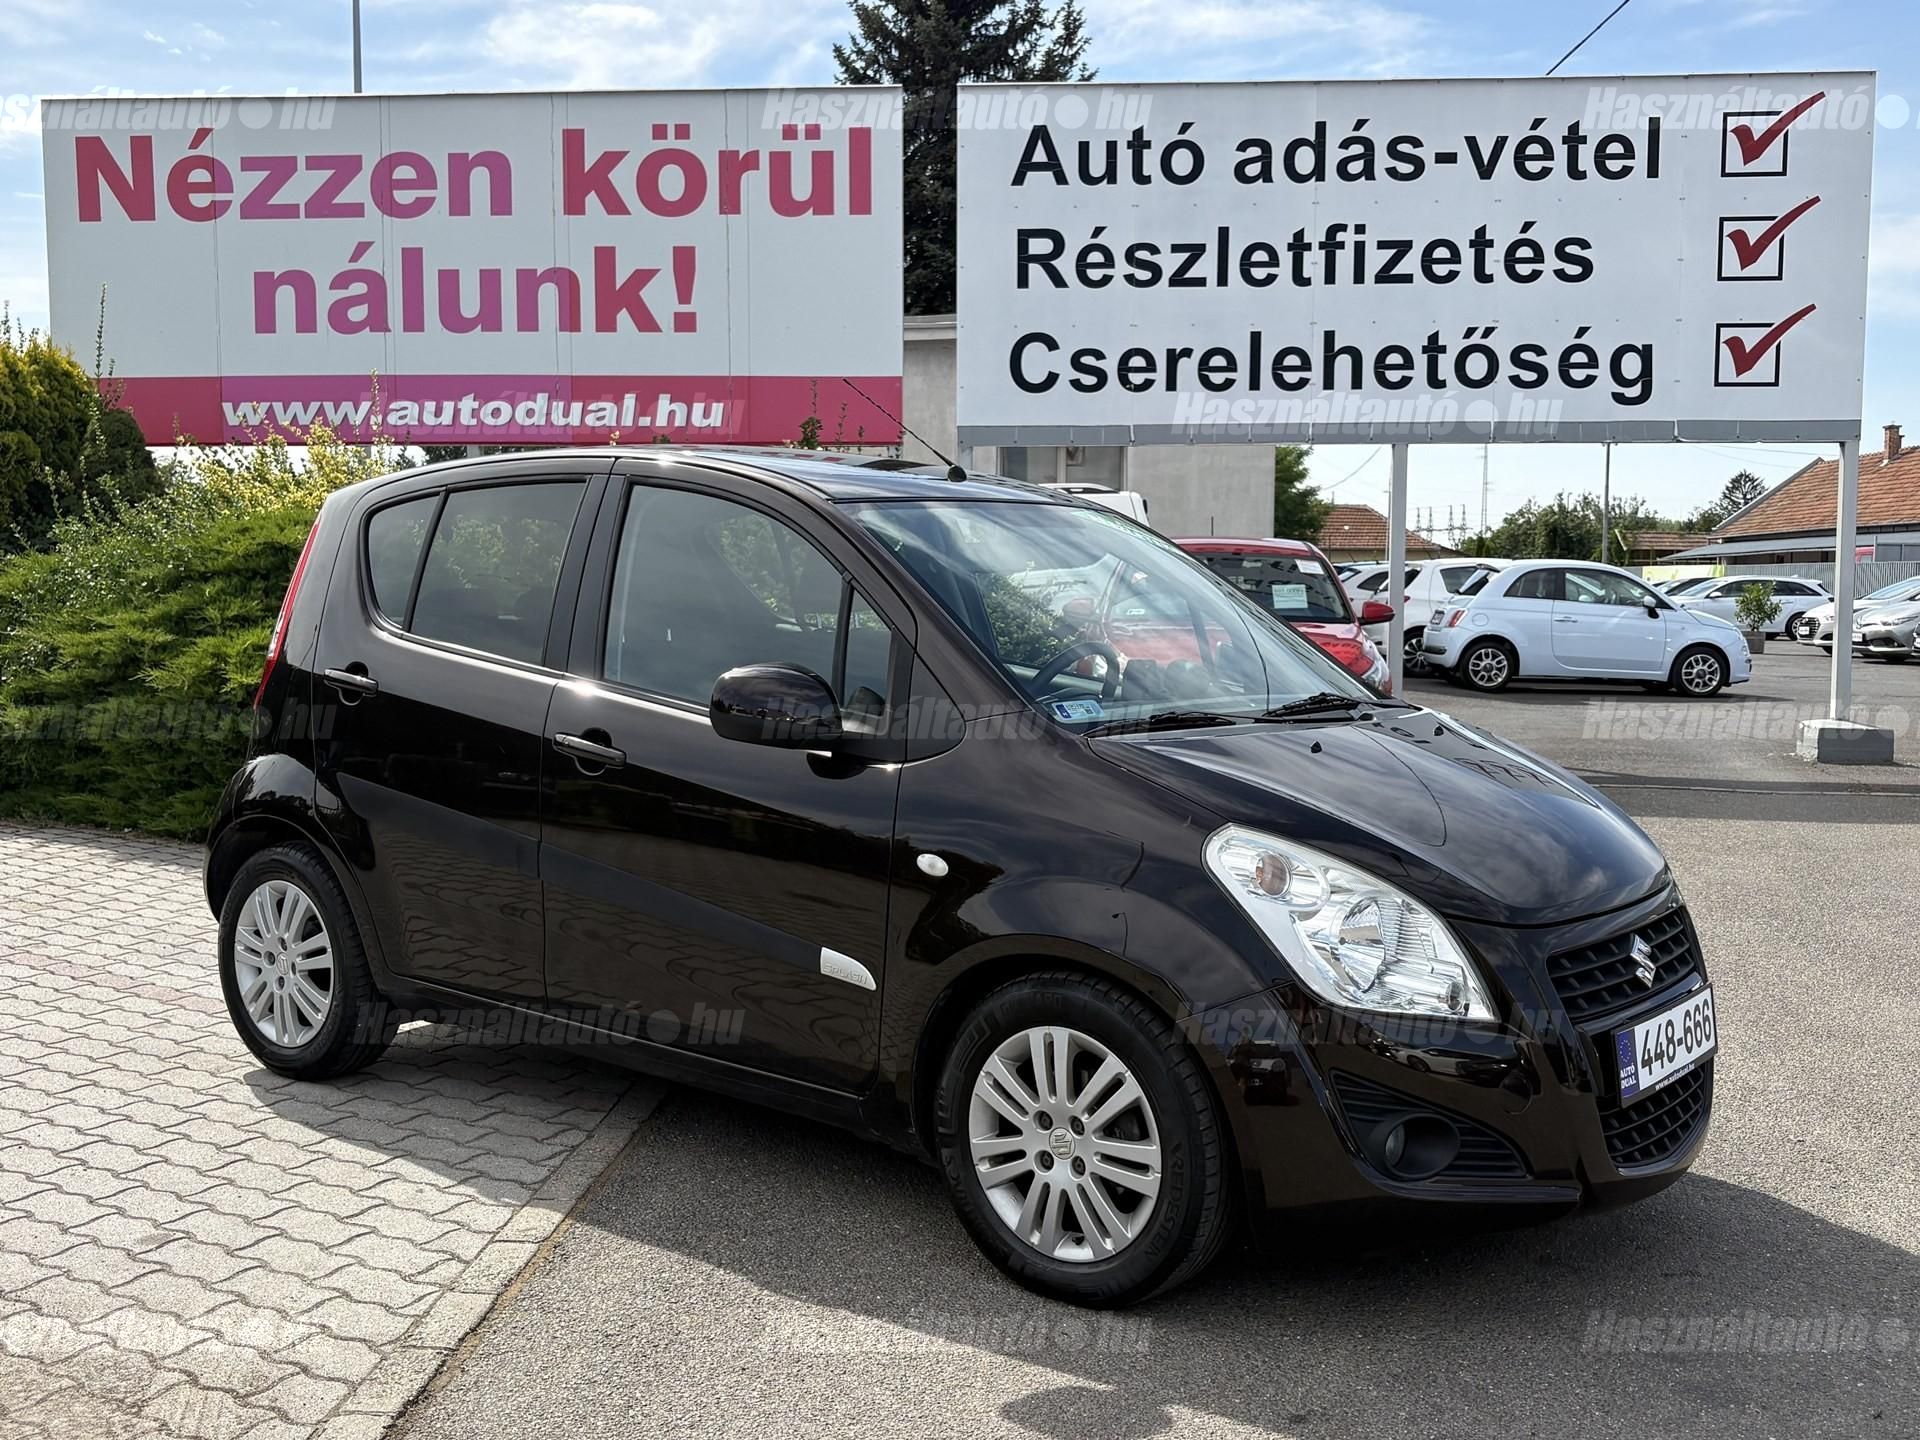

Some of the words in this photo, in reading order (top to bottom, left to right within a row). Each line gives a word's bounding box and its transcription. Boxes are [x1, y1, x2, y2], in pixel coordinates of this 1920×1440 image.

[75, 127, 513, 223] Nézzen
[562, 123, 873, 218] körül
[1010, 121, 1205, 187] Autó
[1233, 116, 1661, 184] adás-vétel
[253, 241, 698, 335] nálunk!
[1016, 220, 1595, 289] Részletfizetés
[1009, 326, 1655, 406] Cserelehetőség
[222, 393, 725, 428] www.autodual.hu
[1641, 998, 1711, 1076] 448-666
[1621, 1075, 1637, 1089] DUAL
